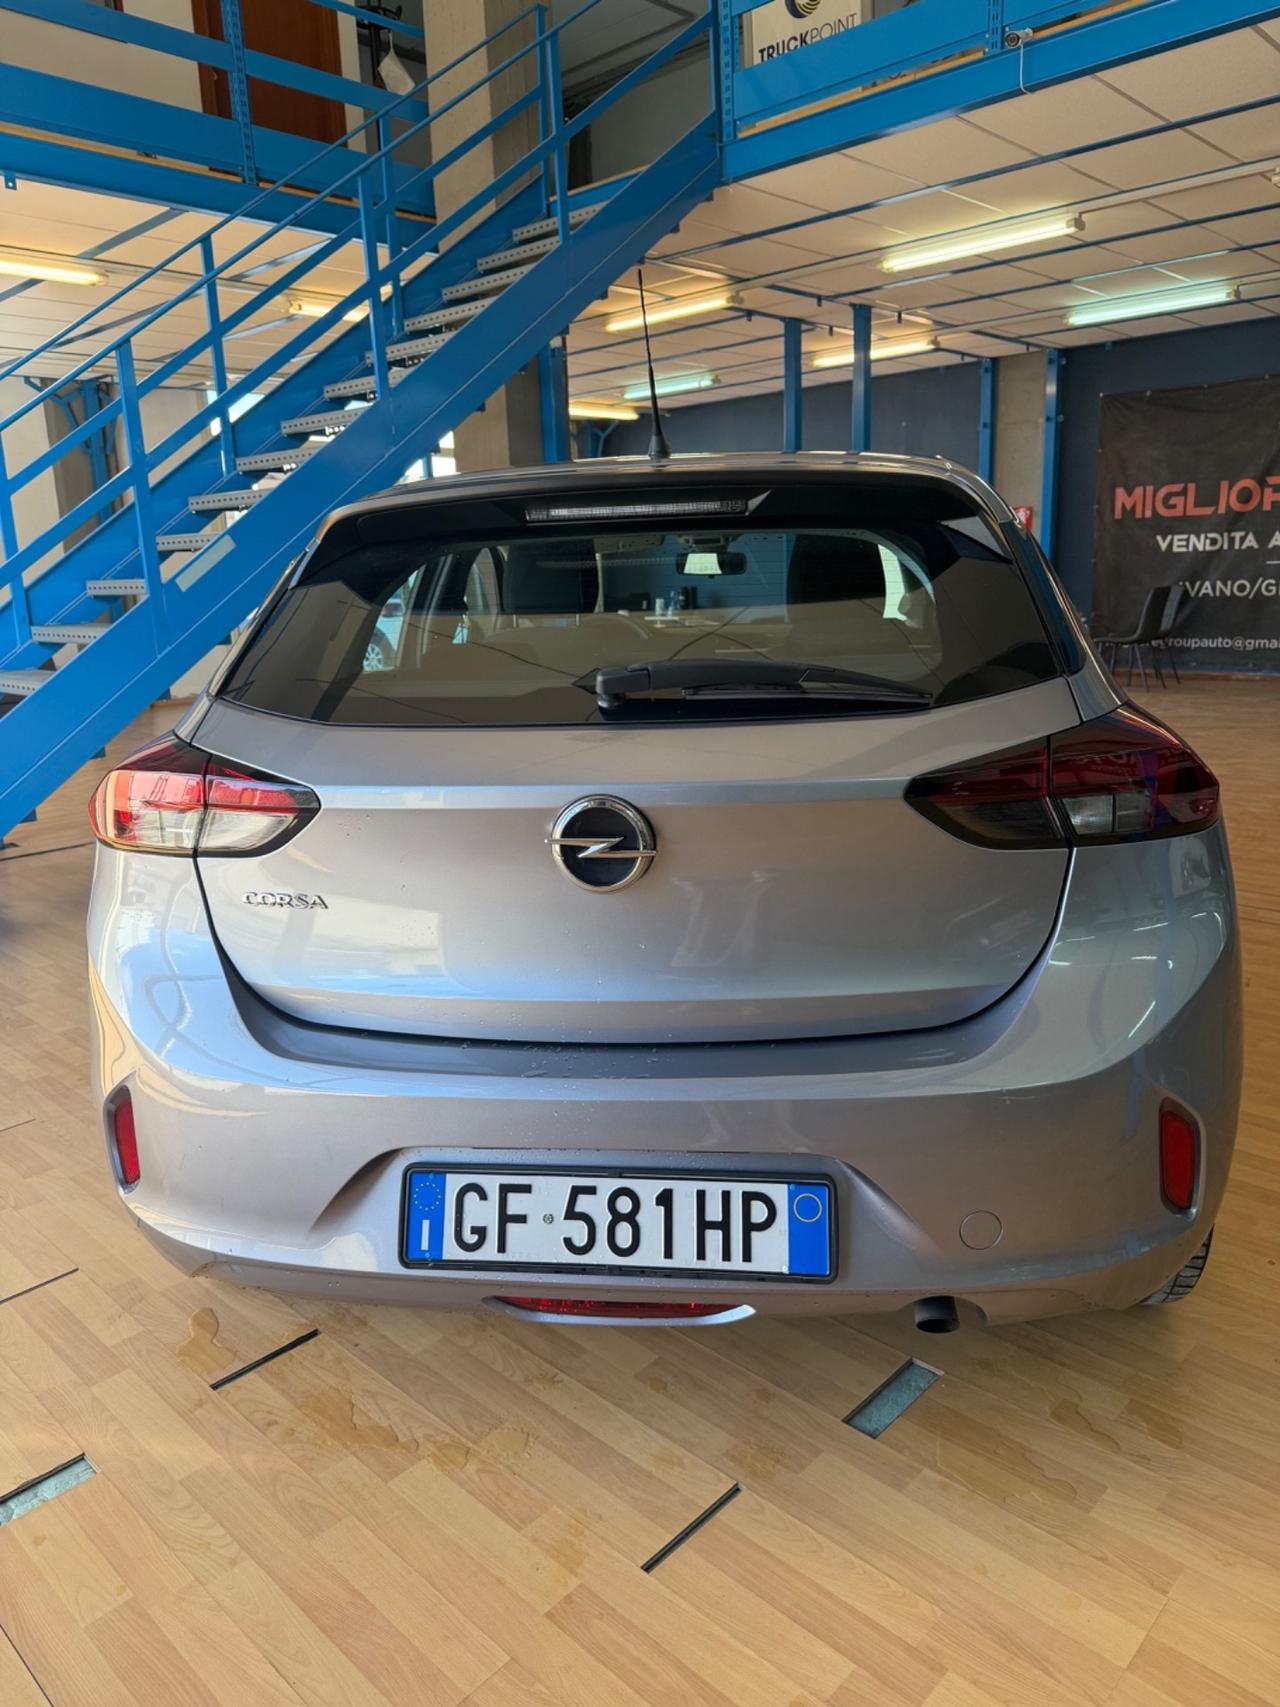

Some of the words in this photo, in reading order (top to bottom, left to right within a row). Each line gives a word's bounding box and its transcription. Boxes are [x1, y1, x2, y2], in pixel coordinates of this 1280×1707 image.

[758, 13, 857, 62] TRUCKPOINT
[1156, 531, 1259, 552] VENDITA
[1178, 577, 1280, 600] VANO/G
[242, 891, 329, 909] CORSA
[453, 1182, 533, 1255] GF
[561, 1184, 778, 1264] 581HP
